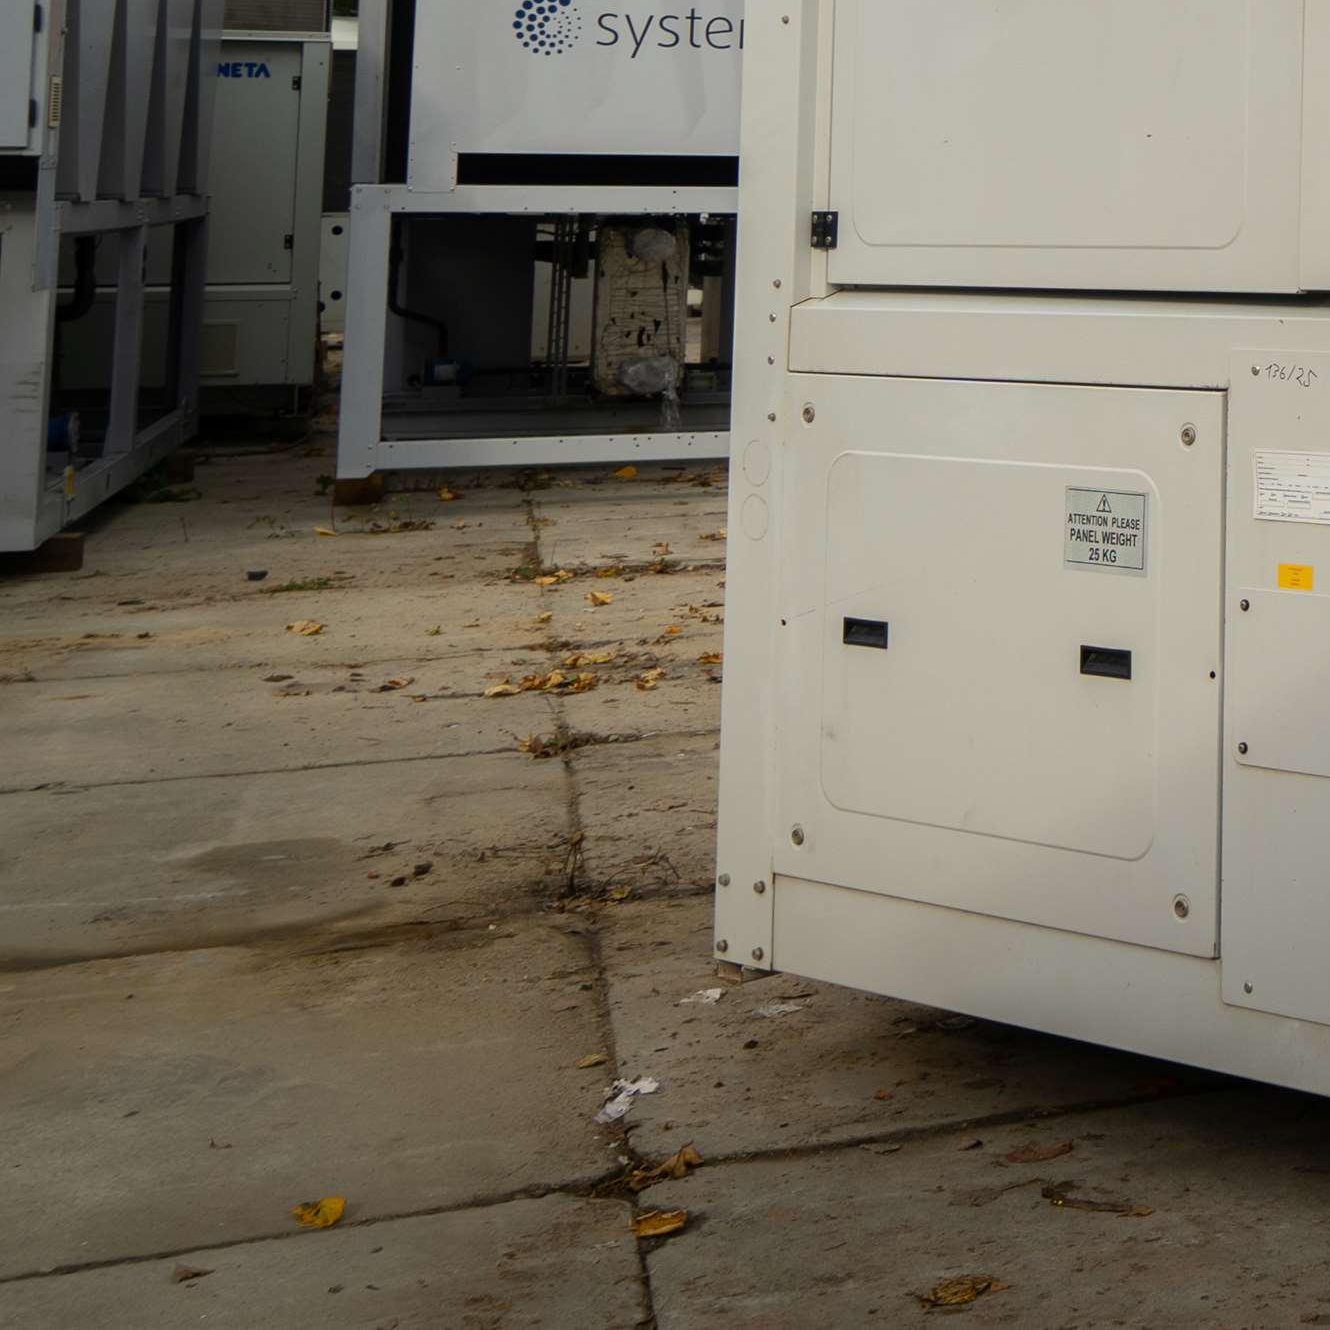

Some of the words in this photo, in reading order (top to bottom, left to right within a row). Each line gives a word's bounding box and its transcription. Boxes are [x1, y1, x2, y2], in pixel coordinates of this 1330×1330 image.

[1067, 513, 1108, 527] ATTENTION
[1111, 517, 1141, 530] PLEASE
[1069, 528, 1099, 544] PANEL
[1102, 531, 1138, 547] WEIGHT
[1088, 547, 1100, 561] 25
[1102, 548, 1117, 563] KG
